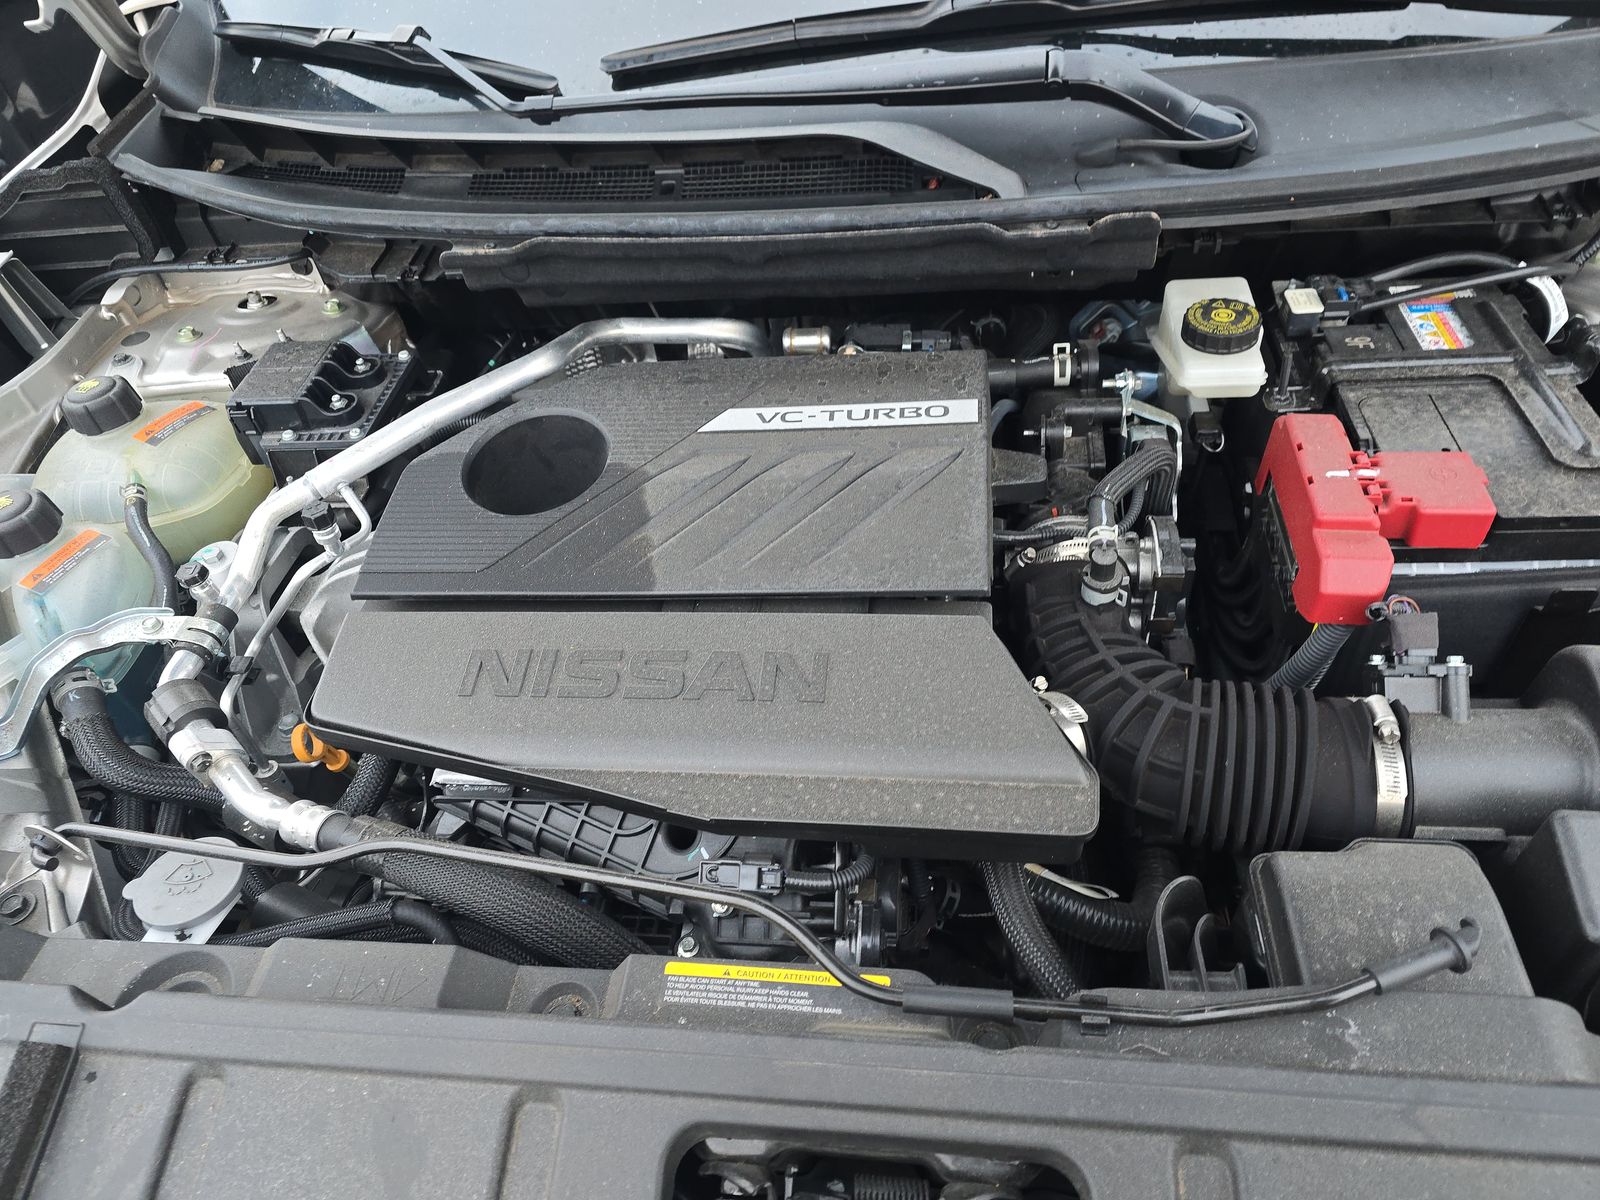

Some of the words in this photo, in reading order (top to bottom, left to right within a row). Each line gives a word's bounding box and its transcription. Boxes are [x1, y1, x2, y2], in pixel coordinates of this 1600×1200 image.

[756, 405, 950, 424] VC-TURBO
[456, 648, 830, 703] NISSAN
[736, 970, 775, 980] CAUTION
[783, 973, 831, 983] ATTENTION
[673, 989, 707, 997] VENTILATEUR
[707, 984, 735, 992] PERSONAL
